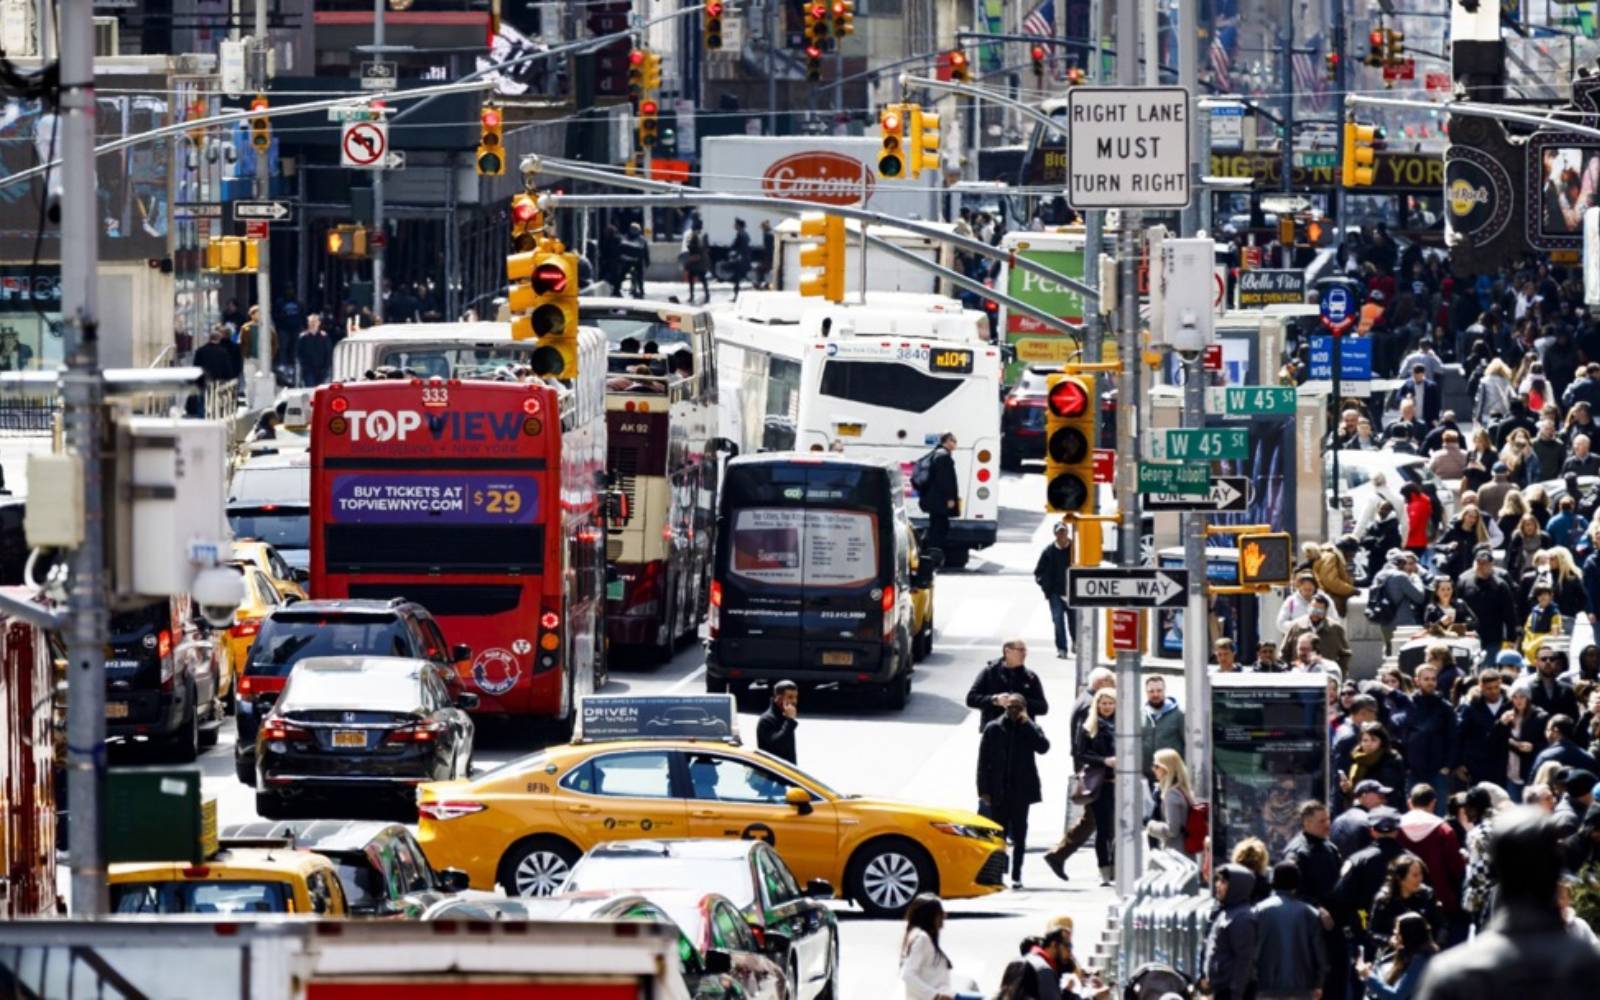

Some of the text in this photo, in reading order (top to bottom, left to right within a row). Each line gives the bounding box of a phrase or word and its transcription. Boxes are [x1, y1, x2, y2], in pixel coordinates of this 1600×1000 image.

[1074, 103, 1183, 122] RIGHT LANE
[1097, 136, 1160, 159] MUST
[1389, 157, 1443, 185] YOR
[1074, 173, 1120, 192] TURN
[1132, 173, 1185, 192] RIGHT
[896, 348, 929, 361] 3840
[422, 388, 448, 401] 333
[1230, 390, 1294, 410] W 45 St
[344, 410, 525, 442] TOP VIEW
[621, 424, 635, 432] AK
[1171, 434, 1189, 456] W
[1198, 433, 1222, 455] 45
[1231, 433, 1244, 447] St
[1303, 415, 1314, 473] Newsstand
[1140, 466, 1207, 486] George Abbott
[354, 486, 462, 498] BUY TICKETS AT
[339, 499, 463, 511] TOPVIEWNYC.COM
[1085, 580, 1172, 595] ONE WAY
[584, 707, 638, 715] DRIVEN
